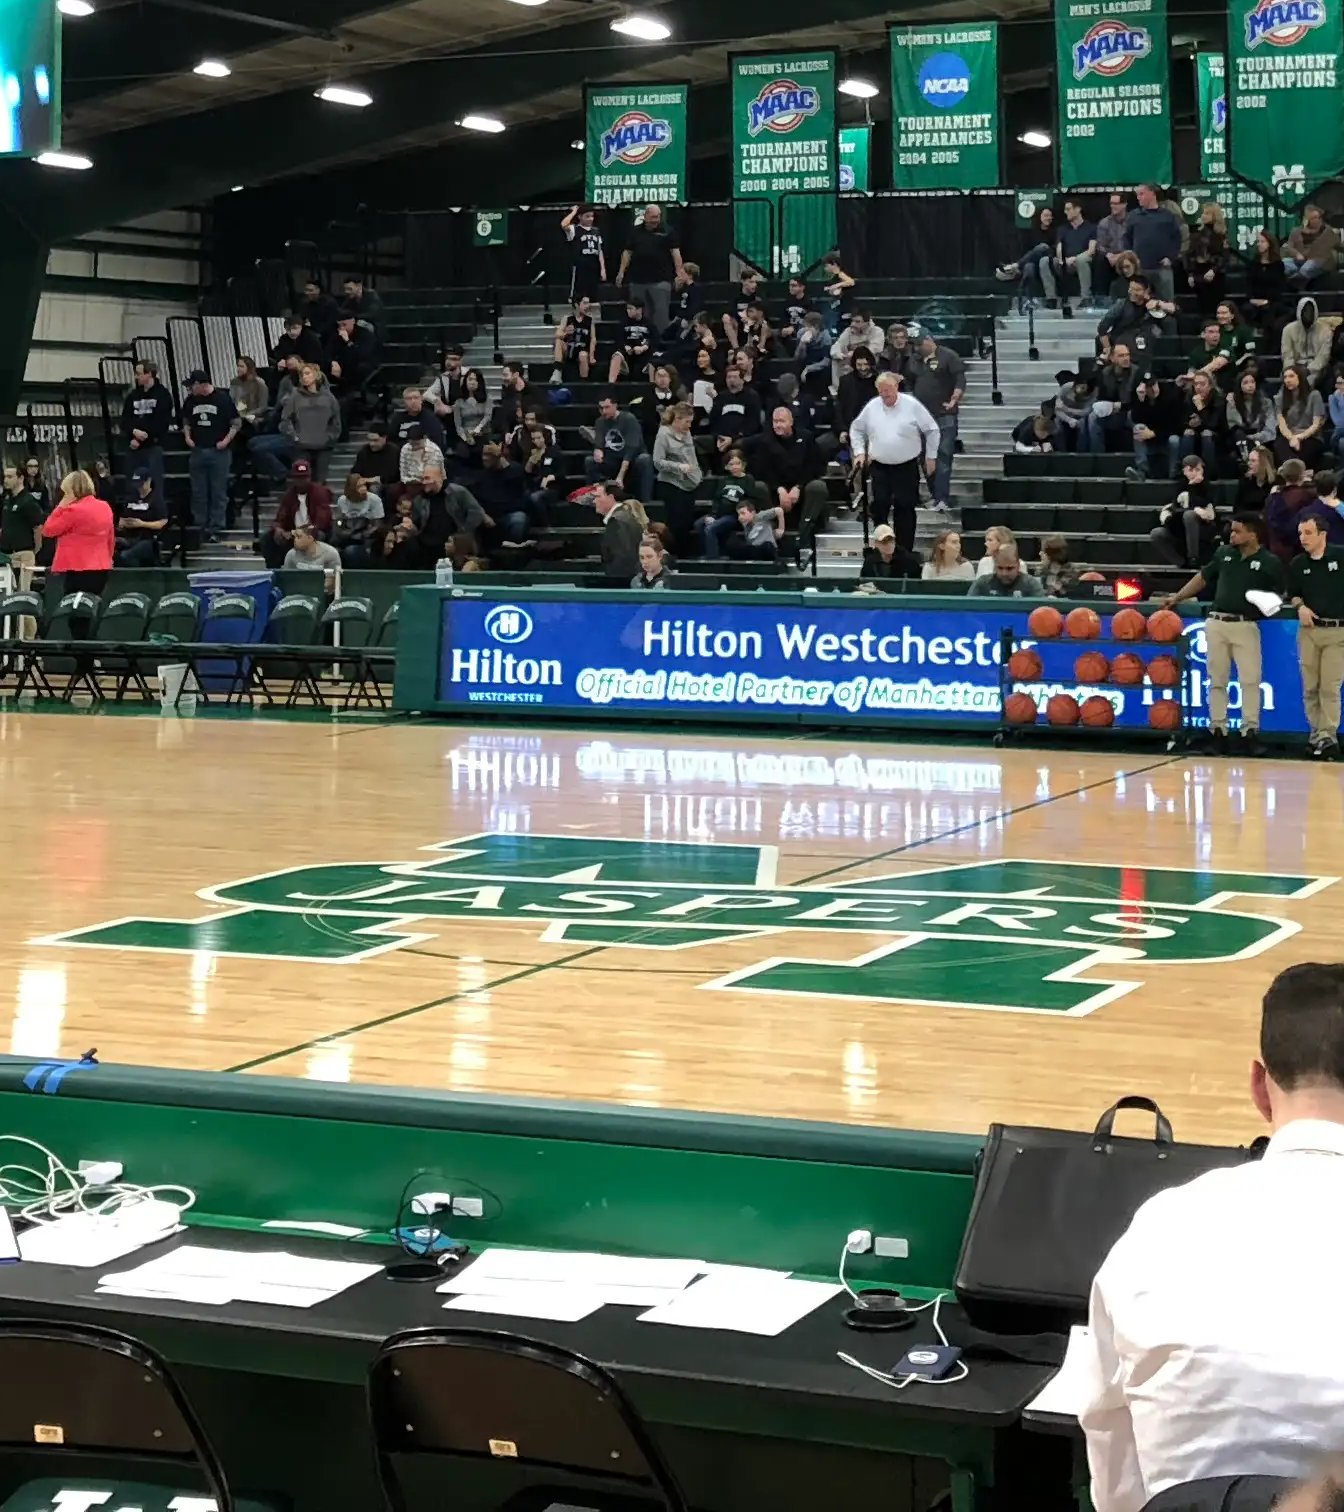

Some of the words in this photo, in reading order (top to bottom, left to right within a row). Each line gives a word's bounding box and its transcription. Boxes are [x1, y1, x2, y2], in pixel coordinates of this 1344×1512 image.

[1070, 3, 1100, 16] MEN'S
[1102, 0, 1151, 14] LACROSSE
[1244, 2, 1322, 43] MAAC
[897, 32, 942, 46] WOMEN'S
[944, 30, 991, 43] LACROSSE
[1076, 28, 1146, 70] MAAC
[739, 61, 781, 75] WOMEN'S
[785, 60, 829, 73] LACROSSE
[1237, 55, 1336, 72] TOURNAMENT
[922, 78, 968, 94] NCAA
[1238, 72, 1336, 90] CHAMPIONS
[592, 94, 632, 107] WOMEN'S
[634, 93, 682, 105] LACROSSE
[1067, 86, 1114, 99] REGULAR
[1118, 85, 1160, 96] SEASON
[751, 88, 816, 127] MAAC
[1067, 99, 1162, 119] CHAMPIONS
[899, 114, 991, 130] TOURNAMENT
[604, 119, 668, 157] MAAC
[899, 130, 992, 147] APPEARANCES
[741, 141, 828, 156] TOURNAMENT
[742, 156, 828, 174] CHAMPIONS
[931, 151, 959, 164] 2005
[594, 174, 638, 186] REGULAR
[641, 174, 678, 185] SEASON
[772, 178, 800, 190] 2004
[804, 177, 829, 189] 2005
[594, 188, 677, 203] CHAMPIONS
[643, 620, 763, 659] Hilton
[450, 649, 563, 685] Hilton
[469, 692, 543, 702] WESTCHESTER
[577, 669, 665, 702] Official
[669, 672, 735, 701] Hotel
[739, 675, 833, 704] Partner
[835, 678, 867, 710] of
[868, 679, 1001, 711] Manhattan
[286, 878, 1191, 941] JASPERS
